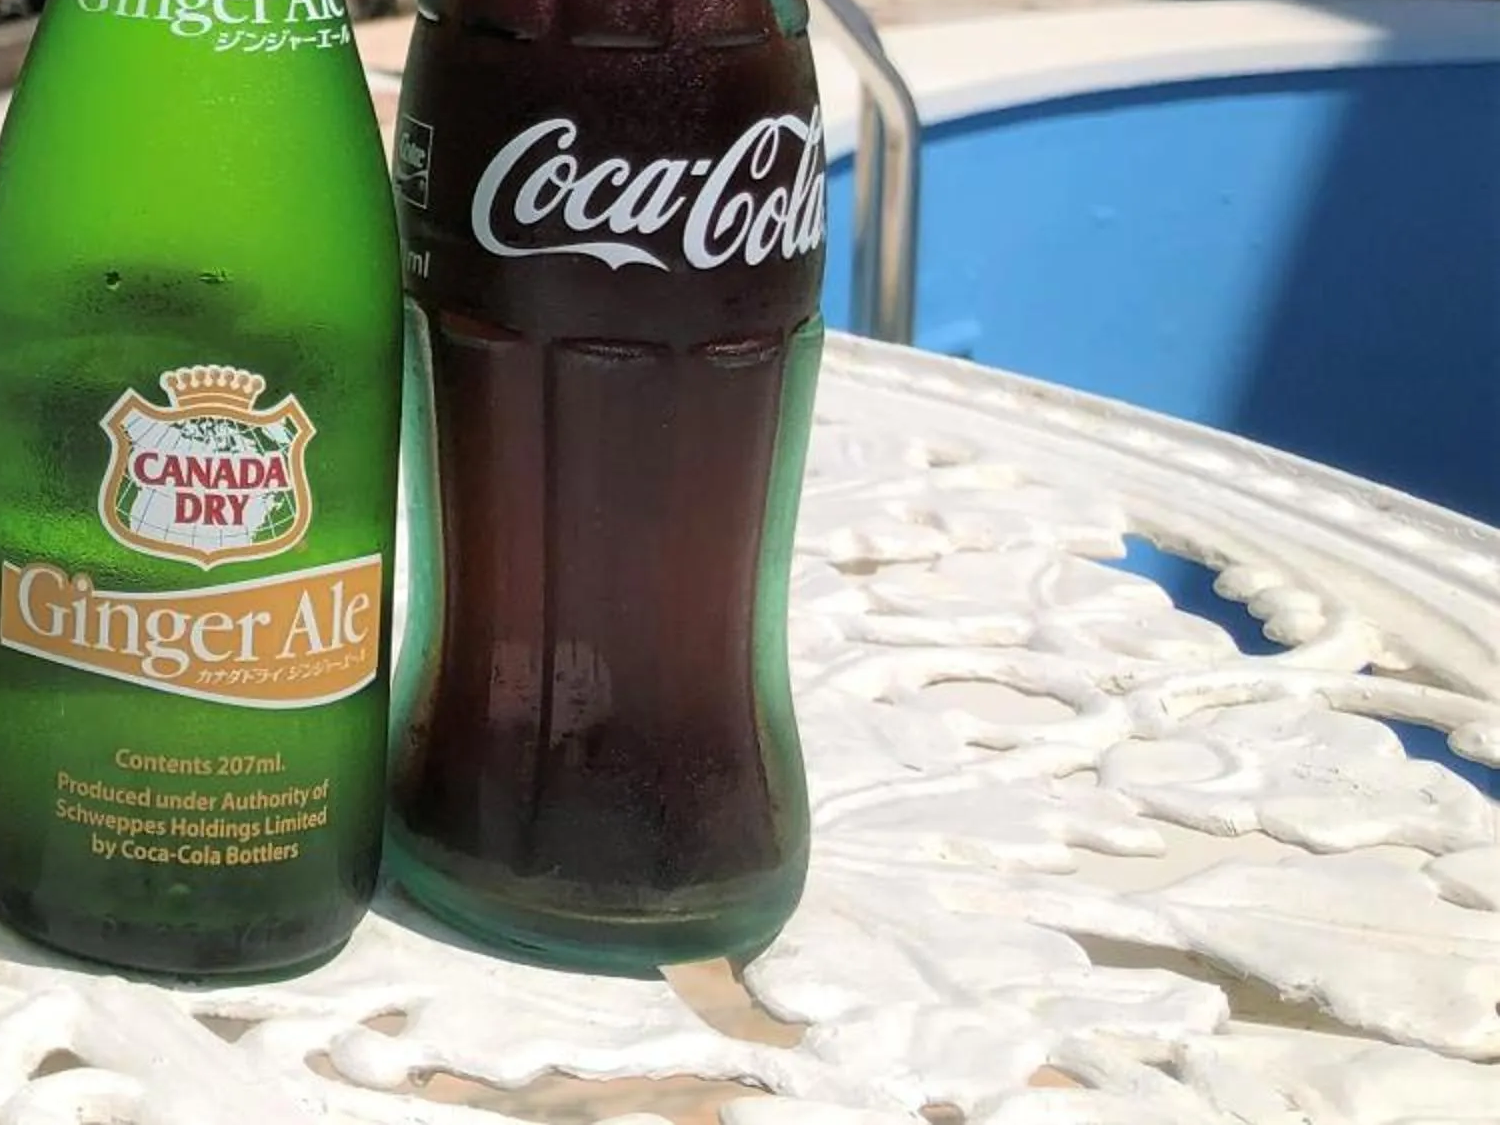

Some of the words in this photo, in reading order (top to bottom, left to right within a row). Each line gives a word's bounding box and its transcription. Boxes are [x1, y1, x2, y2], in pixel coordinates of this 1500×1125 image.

[471, 105, 825, 271] Coca-Cola
[133, 451, 289, 489] CANADA
[174, 492, 250, 526] DRY
[19, 567, 272, 678] Ginger
[276, 581, 370, 660] Ale
[115, 748, 212, 775] Contents
[57, 772, 152, 808] Produced
[155, 789, 217, 811] under
[220, 786, 311, 812] Authority
[311, 779, 330, 801] of
[56, 799, 167, 837] Schweppes
[171, 817, 261, 842] Holdings
[264, 807, 328, 836] Limited
[91, 833, 118, 859] by
[121, 840, 222, 866] Coca-Cola
[225, 842, 299, 866] Bottlers
